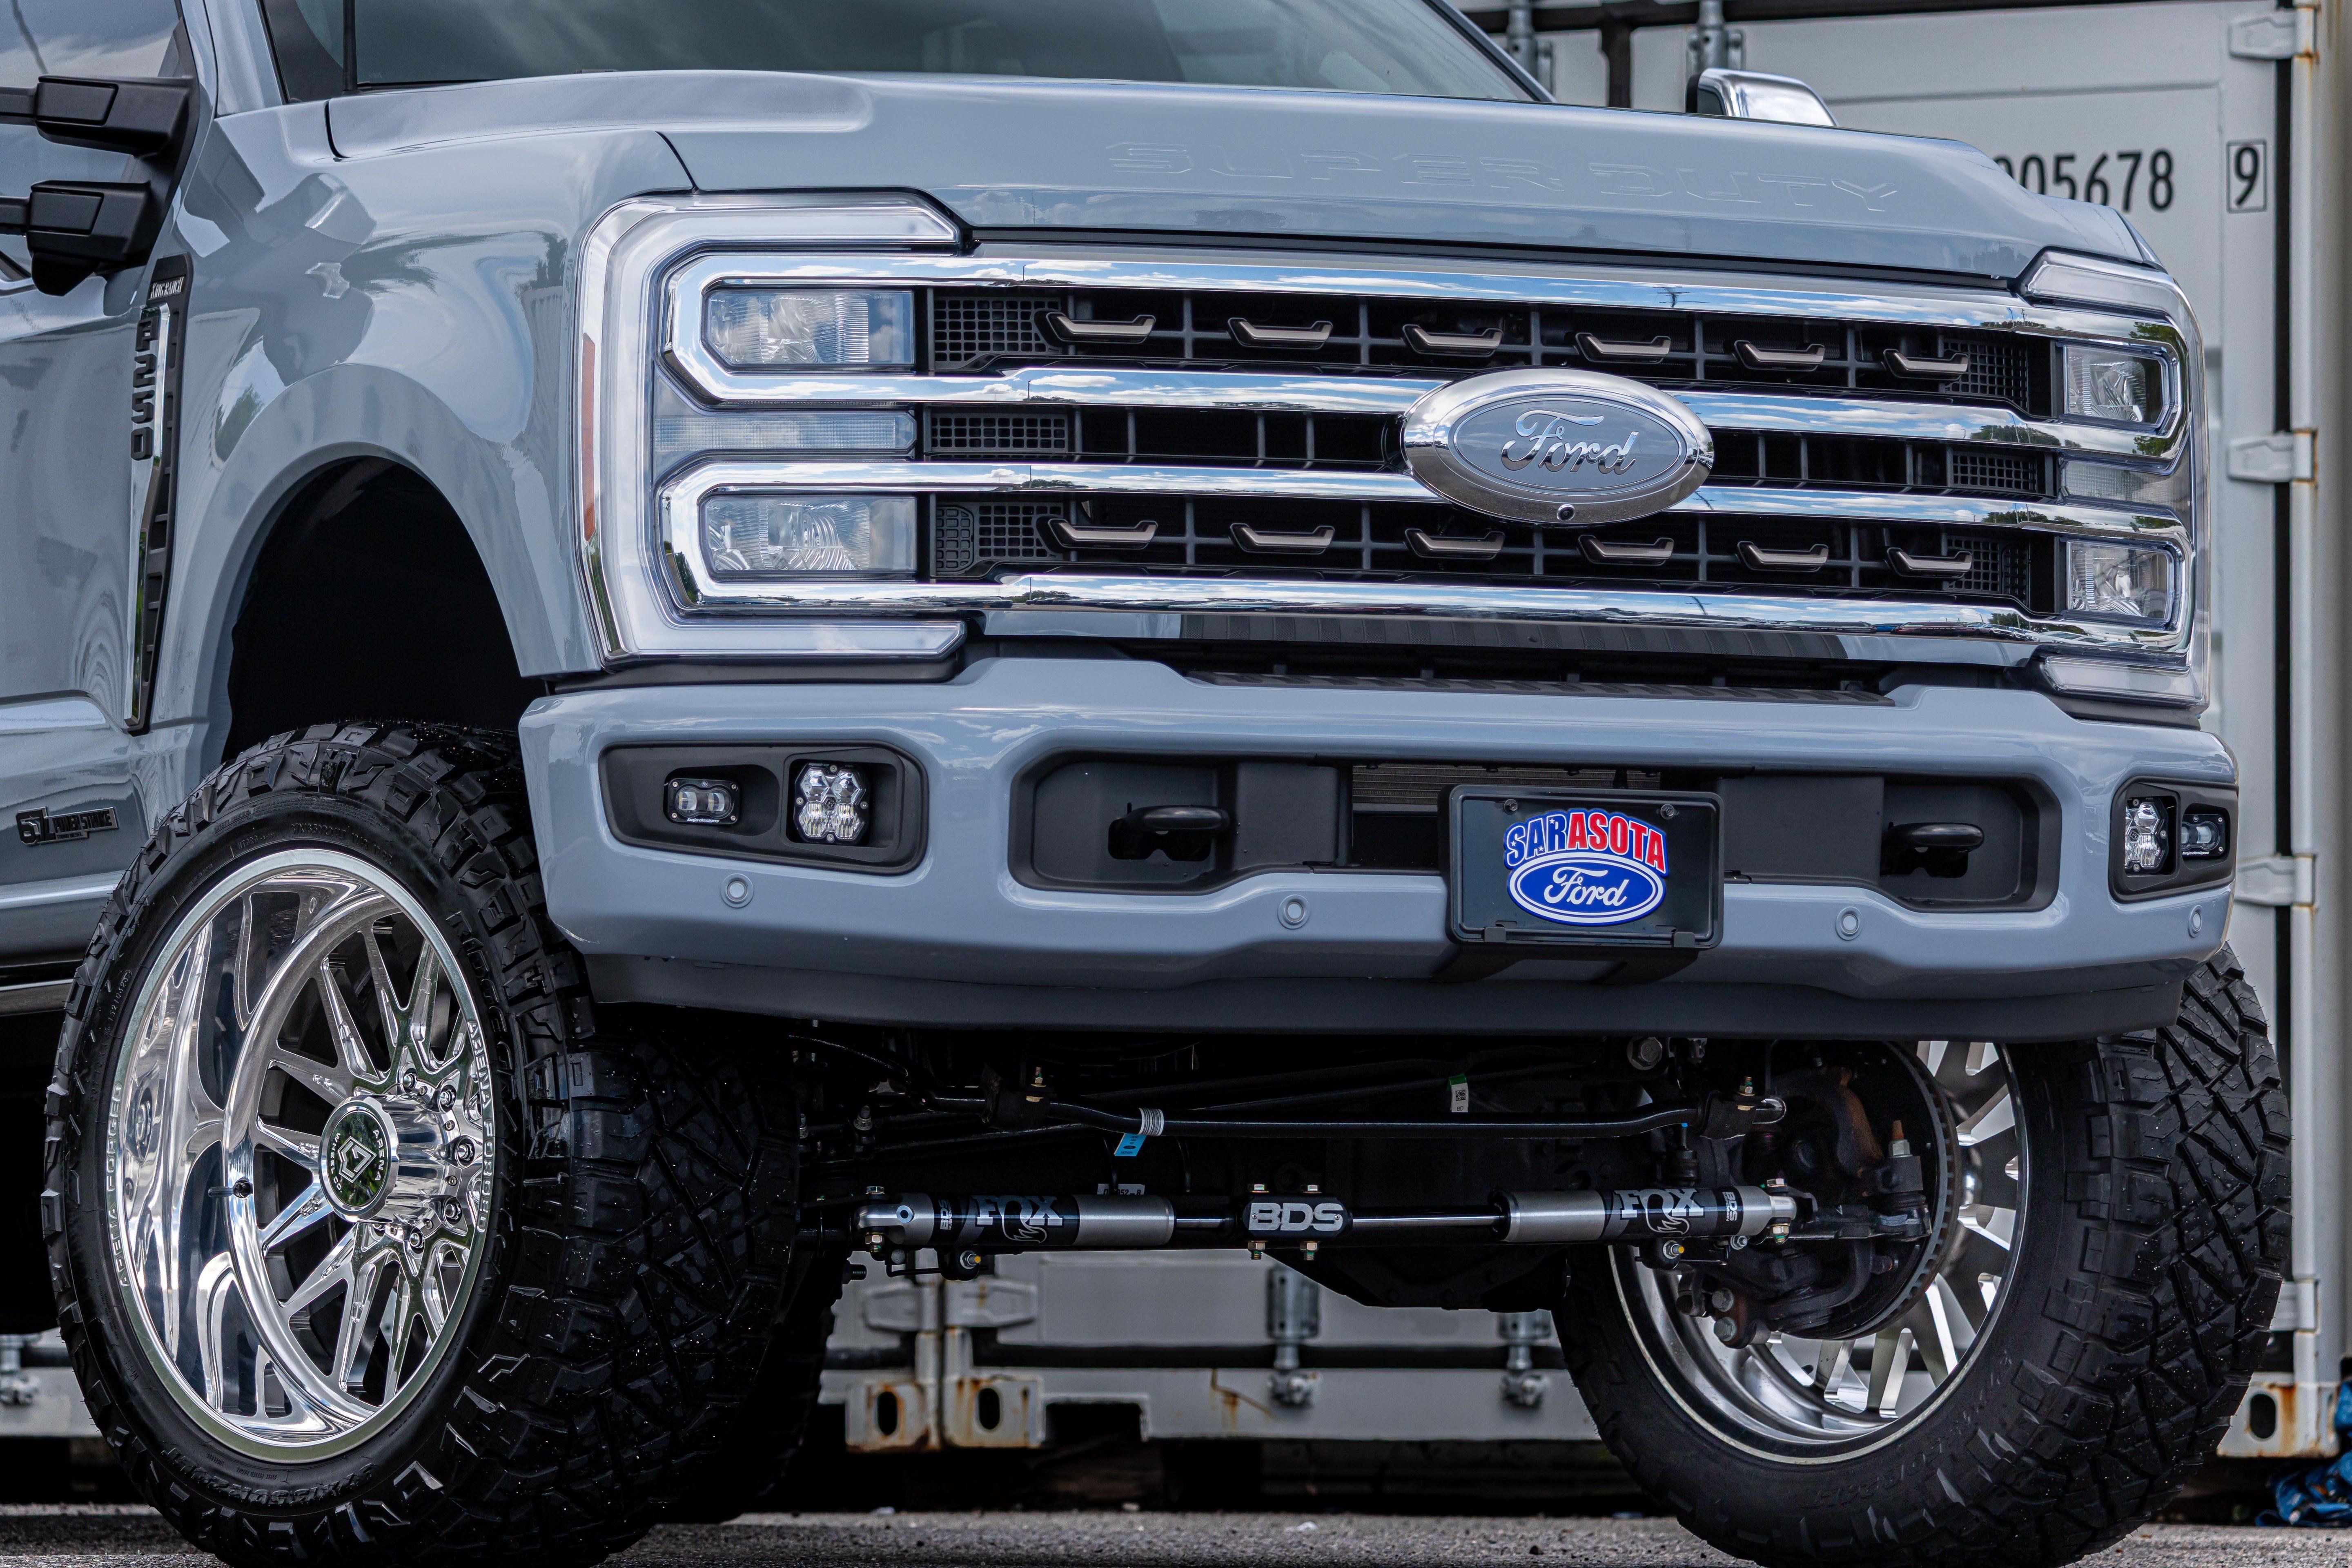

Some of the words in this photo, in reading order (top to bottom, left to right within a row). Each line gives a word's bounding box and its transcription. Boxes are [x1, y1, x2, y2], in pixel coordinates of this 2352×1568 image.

[1105, 141, 1565, 192] SUPER
[1587, 162, 1899, 212] DUTY
[1993, 147, 2174, 212] 05678
[2234, 143, 2260, 207] 9
[1501, 409, 1638, 476] Ford
[52, 814, 81, 834] POWER
[81, 810, 113, 830] STROKE
[1506, 811, 1667, 875] SARASOTA
[1544, 866, 1630, 906] Ford
[467, 1019, 492, 1109] ARENA
[107, 1083, 122, 1192] FORGED
[330, 1132, 341, 1175] WHEEL
[373, 1129, 385, 1181] ARENA
[476, 1120, 494, 1233] FORGED
[939, 1199, 949, 1230] BDS
[971, 1195, 1063, 1237] FOX
[1248, 1202, 1344, 1232] BDS
[1614, 1188, 1704, 1233] FOX
[1726, 1192, 1738, 1221] BDS
[108, 1202, 130, 1287] ARENA
